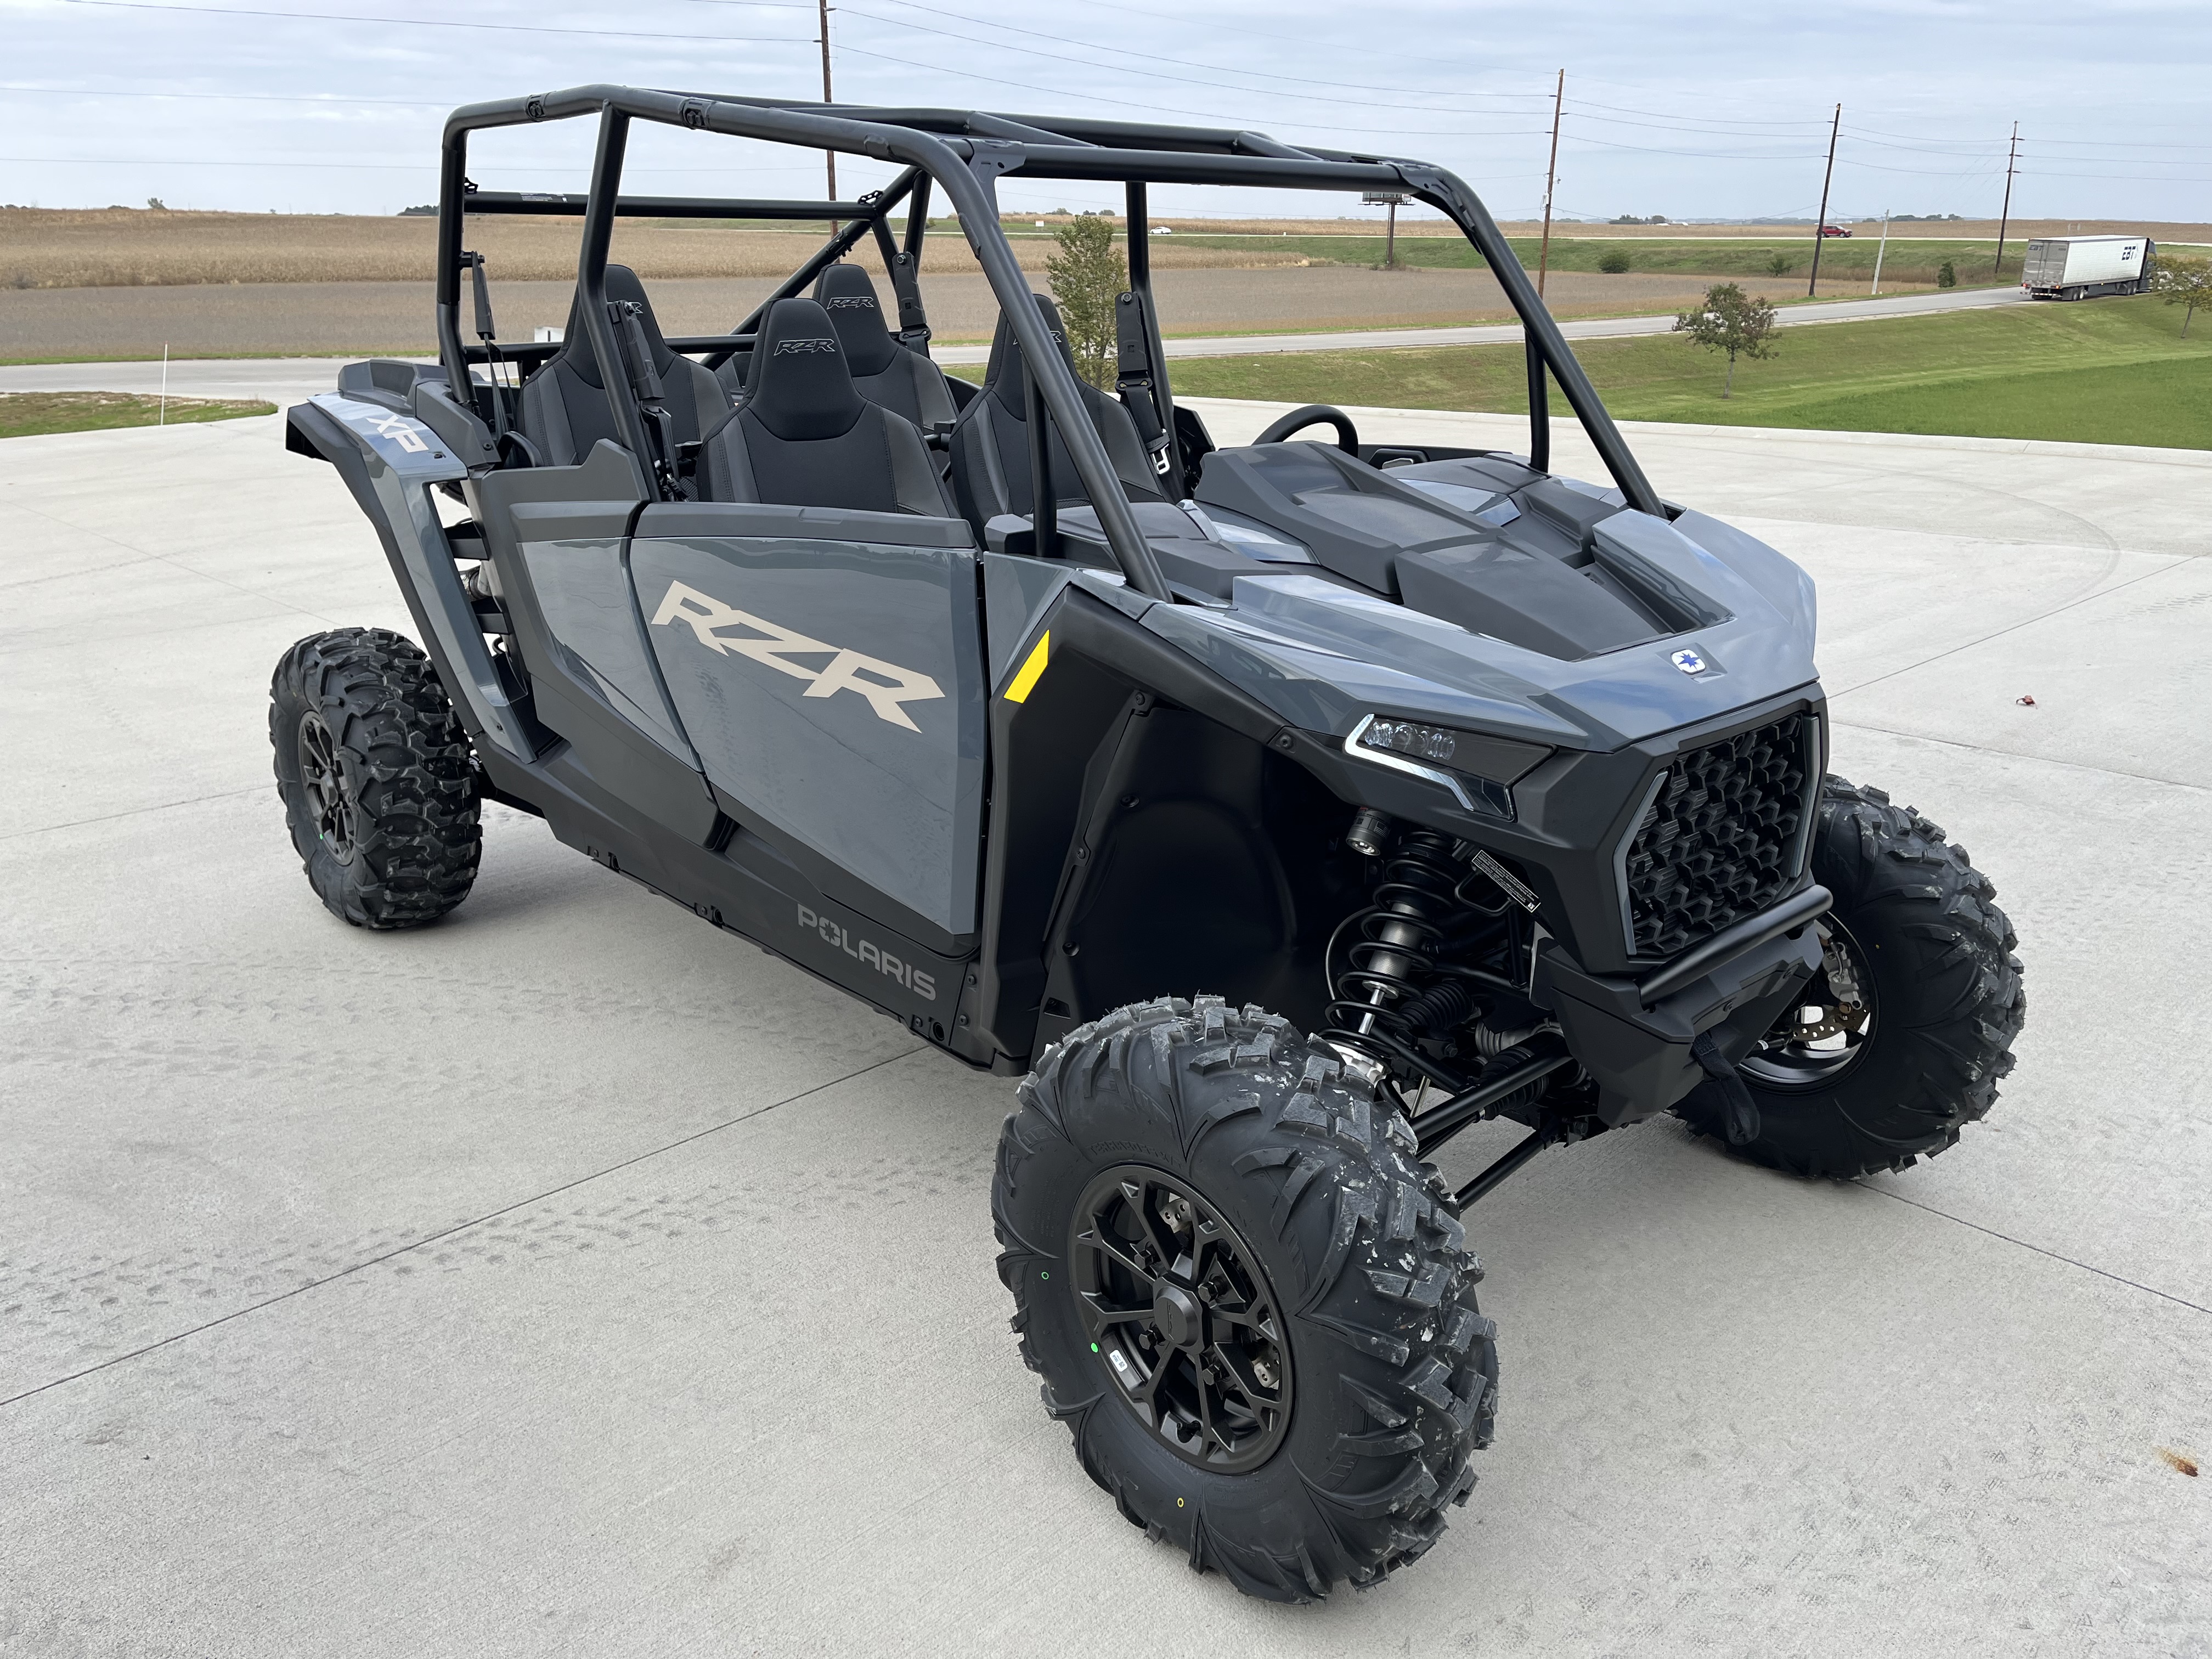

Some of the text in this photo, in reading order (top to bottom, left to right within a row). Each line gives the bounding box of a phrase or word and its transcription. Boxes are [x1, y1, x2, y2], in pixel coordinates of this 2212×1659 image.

[826, 297, 874, 310] RZR
[774, 338, 836, 356] RZR
[365, 414, 429, 453] XP
[651, 580, 946, 734] RZR
[797, 903, 936, 1001] POLARIS
